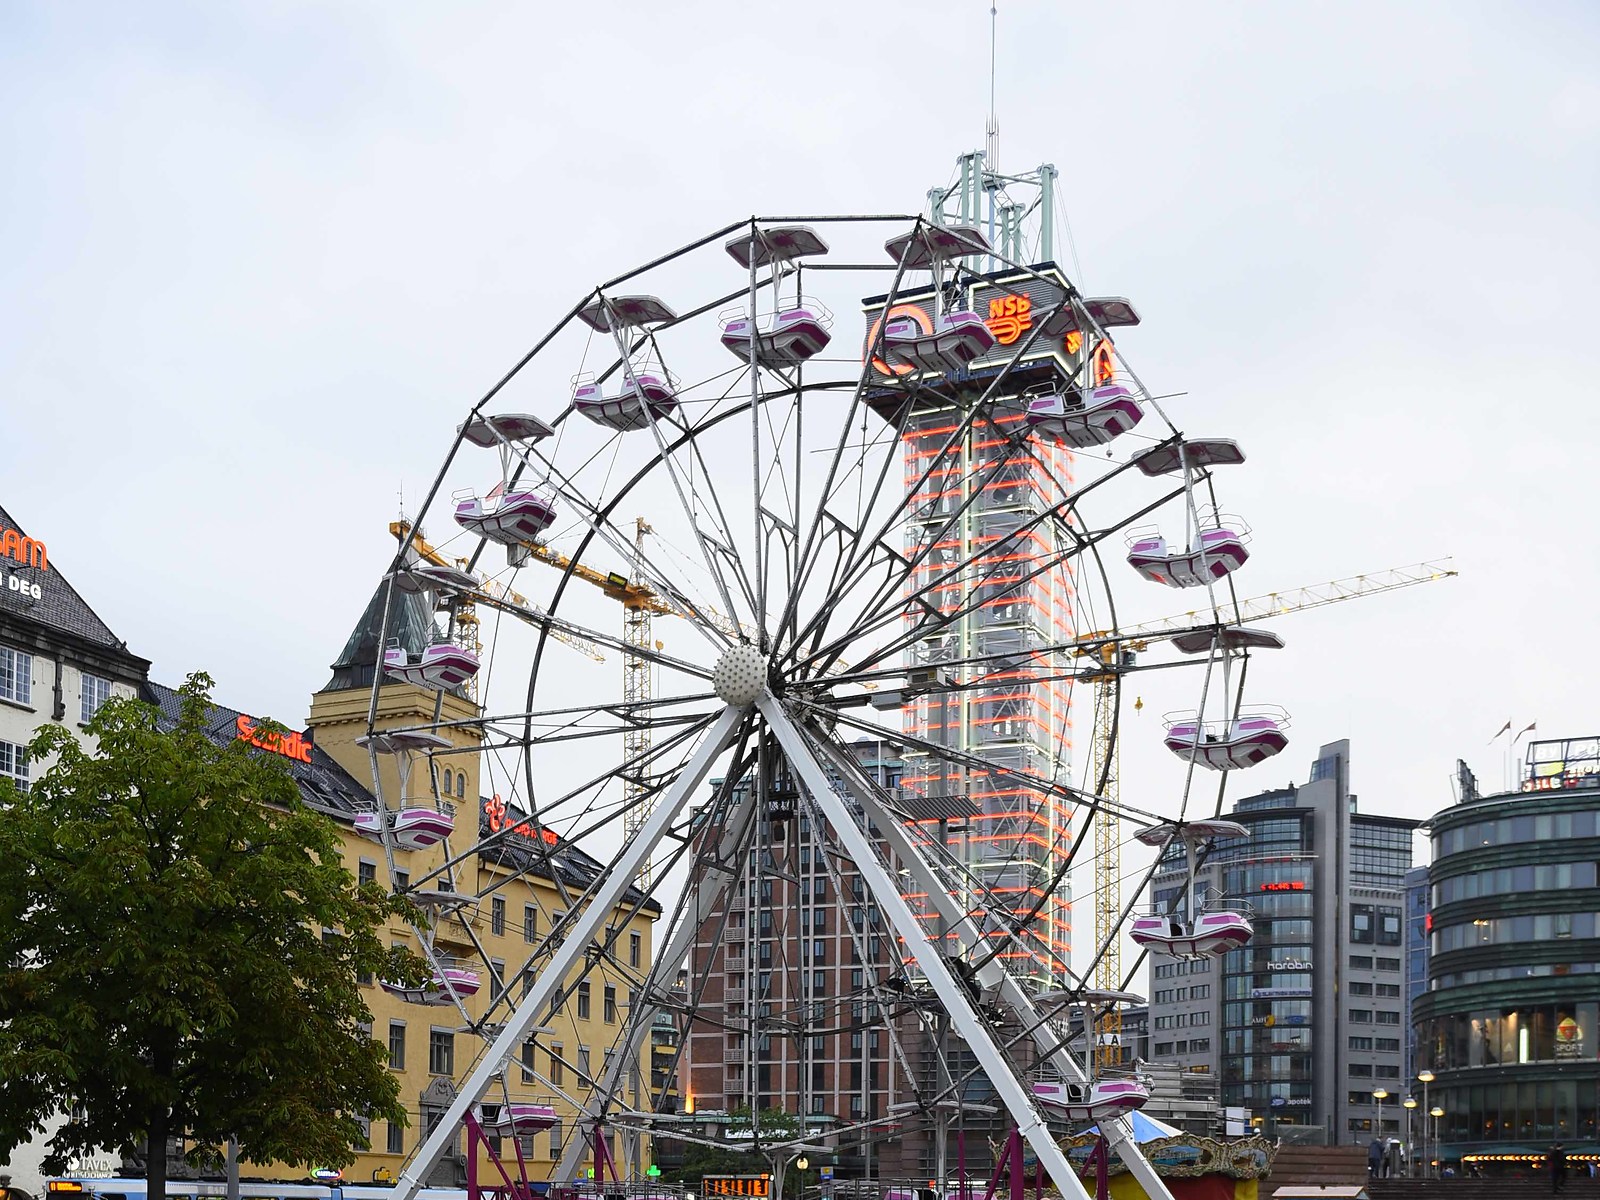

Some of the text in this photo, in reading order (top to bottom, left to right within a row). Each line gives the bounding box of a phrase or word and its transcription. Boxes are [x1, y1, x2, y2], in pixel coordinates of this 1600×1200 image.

[0, 525, 47, 571] AM
[9, 575, 41, 600] DEG
[1287, 1098, 1311, 1106] apotek
[81, 1159, 112, 1171] TAVEX
